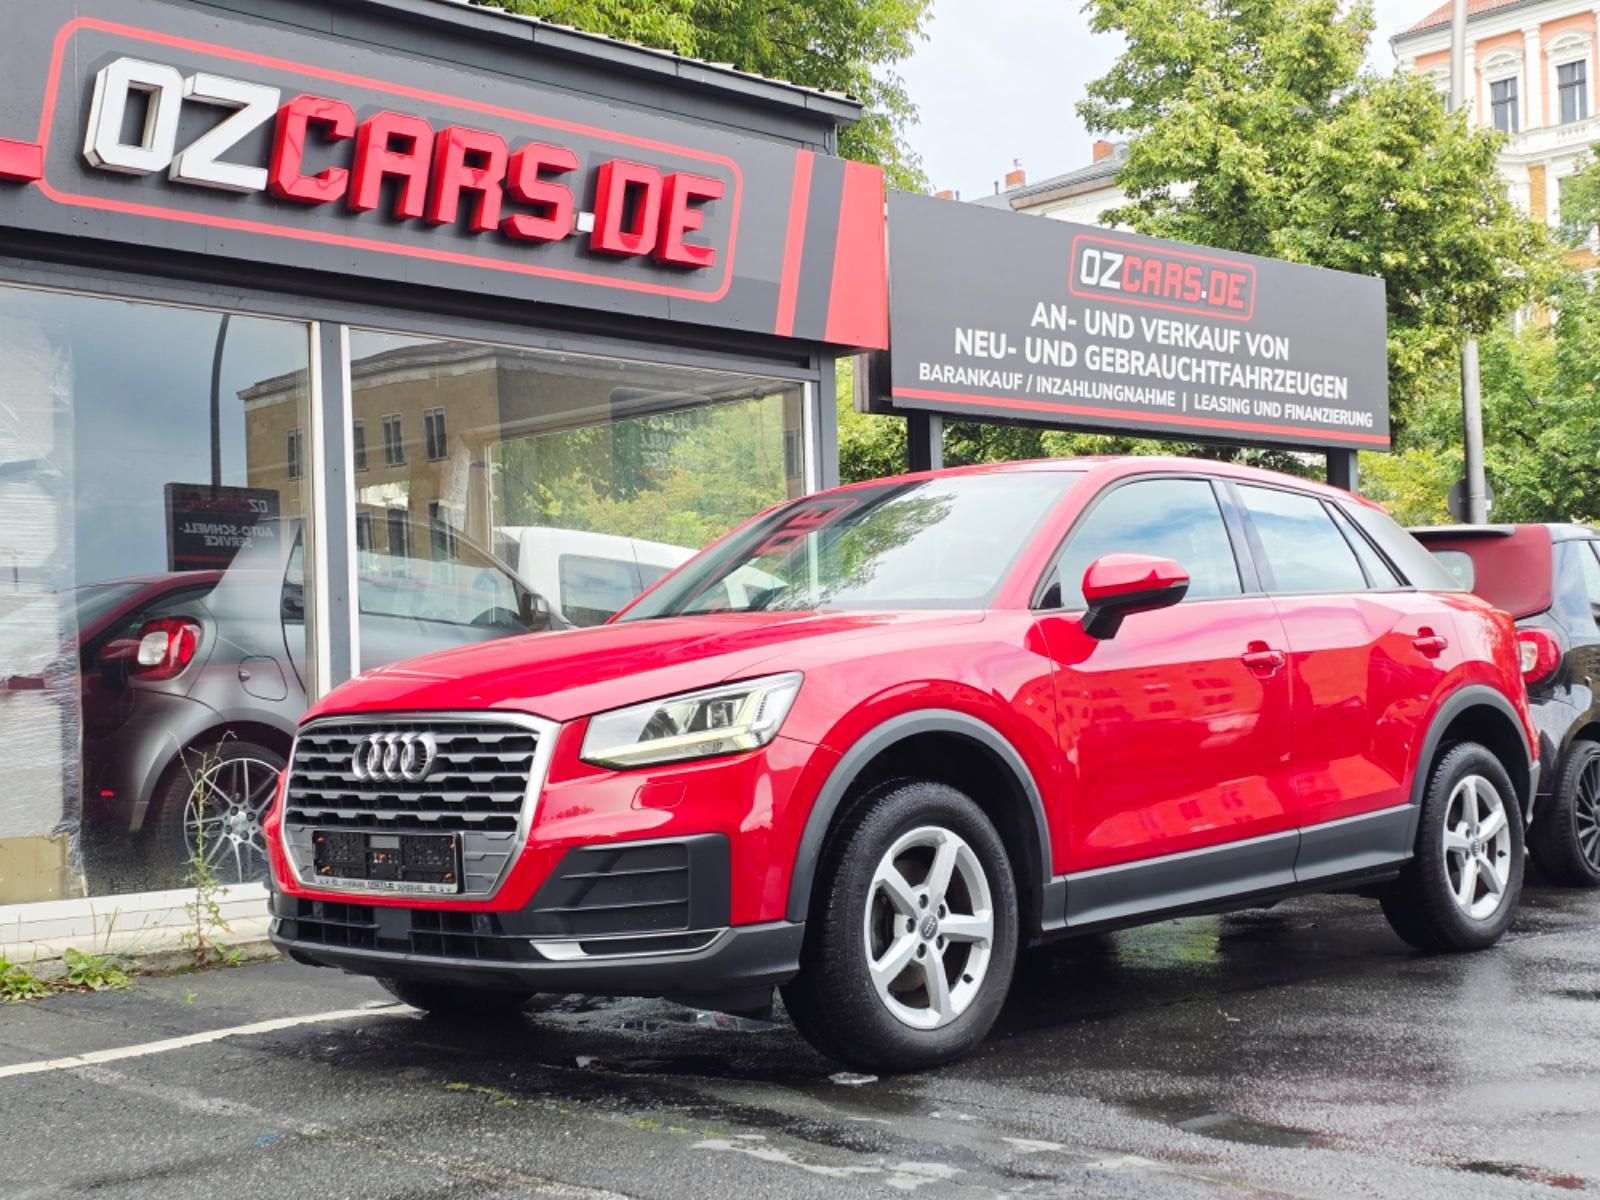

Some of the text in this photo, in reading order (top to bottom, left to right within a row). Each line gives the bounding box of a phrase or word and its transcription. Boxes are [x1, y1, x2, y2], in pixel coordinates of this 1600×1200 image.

[83, 56, 725, 268] OZCARS.DE
[1080, 248, 1247, 309] OZCARS.DE
[955, 327, 1348, 400] NEU- UND GEBRAUCHTFAHRZEUGEN
[1031, 302, 1289, 361] AN- UND VERKAUF VON
[919, 362, 1023, 391] BARANKAUF
[1037, 375, 1176, 408] INZAHLUNGNAHME
[1194, 393, 1250, 416] LEASING
[1254, 402, 1281, 418] UND
[1285, 403, 1373, 428] FINANZIERUNG
